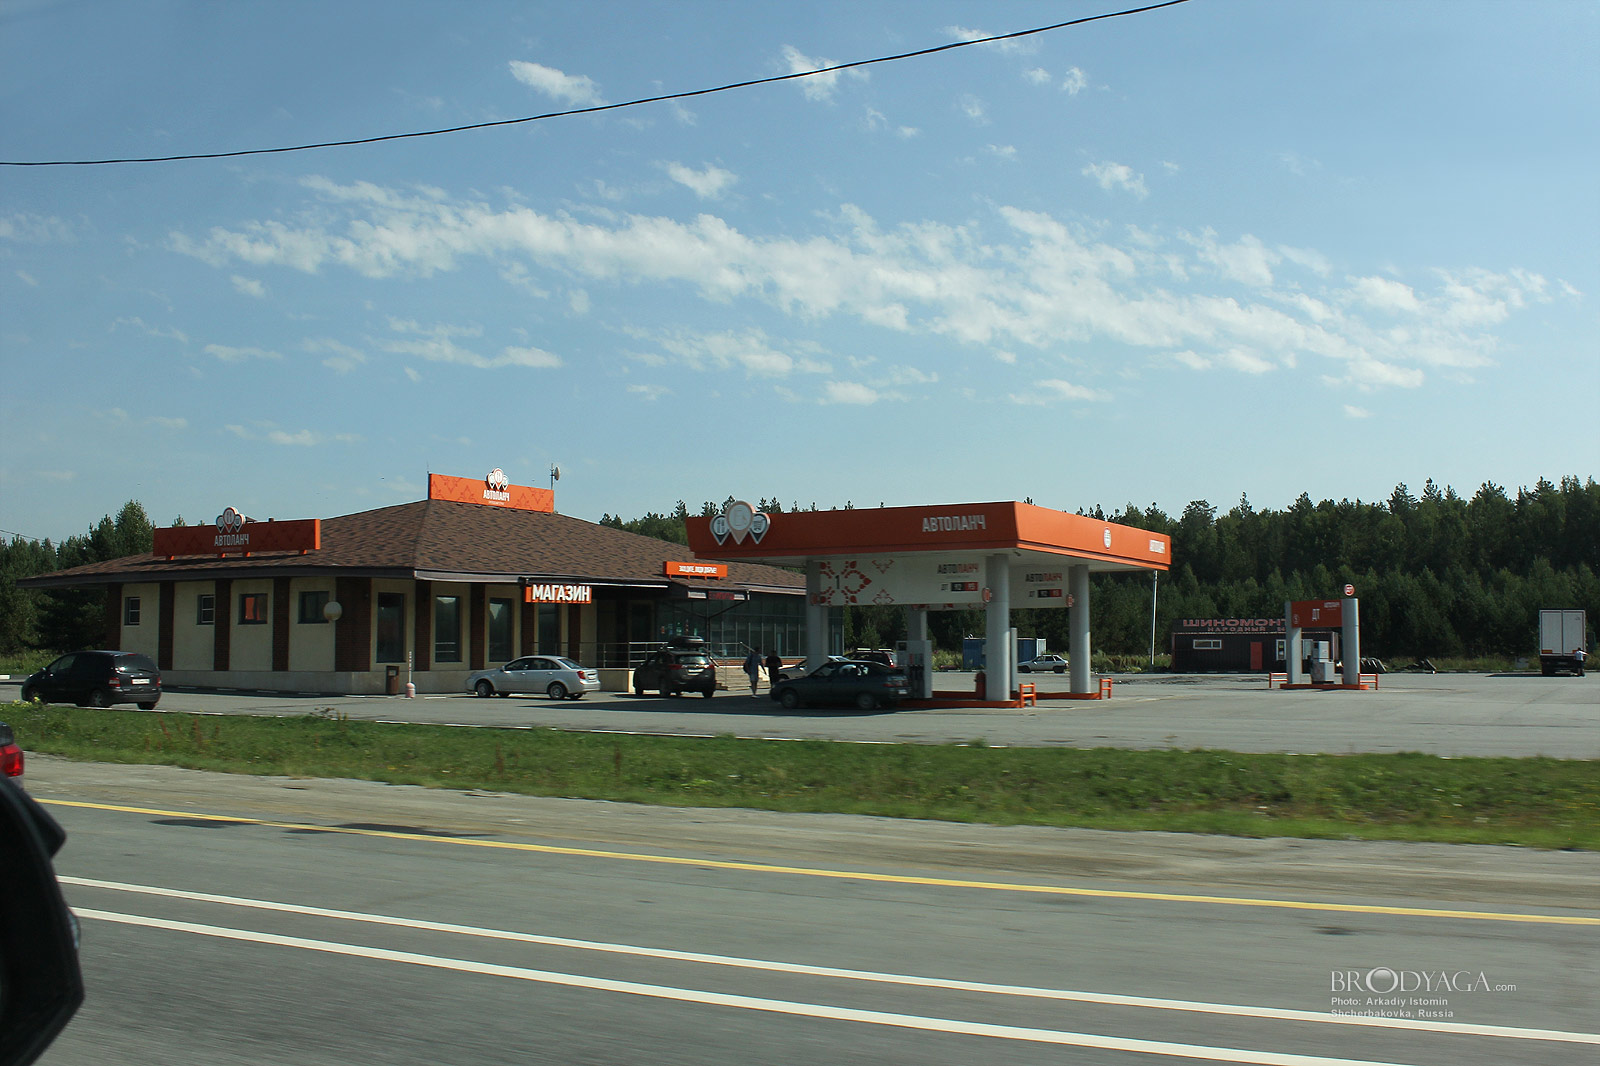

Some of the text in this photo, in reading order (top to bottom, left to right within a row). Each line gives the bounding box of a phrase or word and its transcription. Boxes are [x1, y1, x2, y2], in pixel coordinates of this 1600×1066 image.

[922, 514, 986, 532] АВТОЛАНЧ
[214, 533, 250, 547] АВТОЛАНЧ
[835, 574, 840, 590] 1
[532, 584, 590, 601] МАГАЗИН
